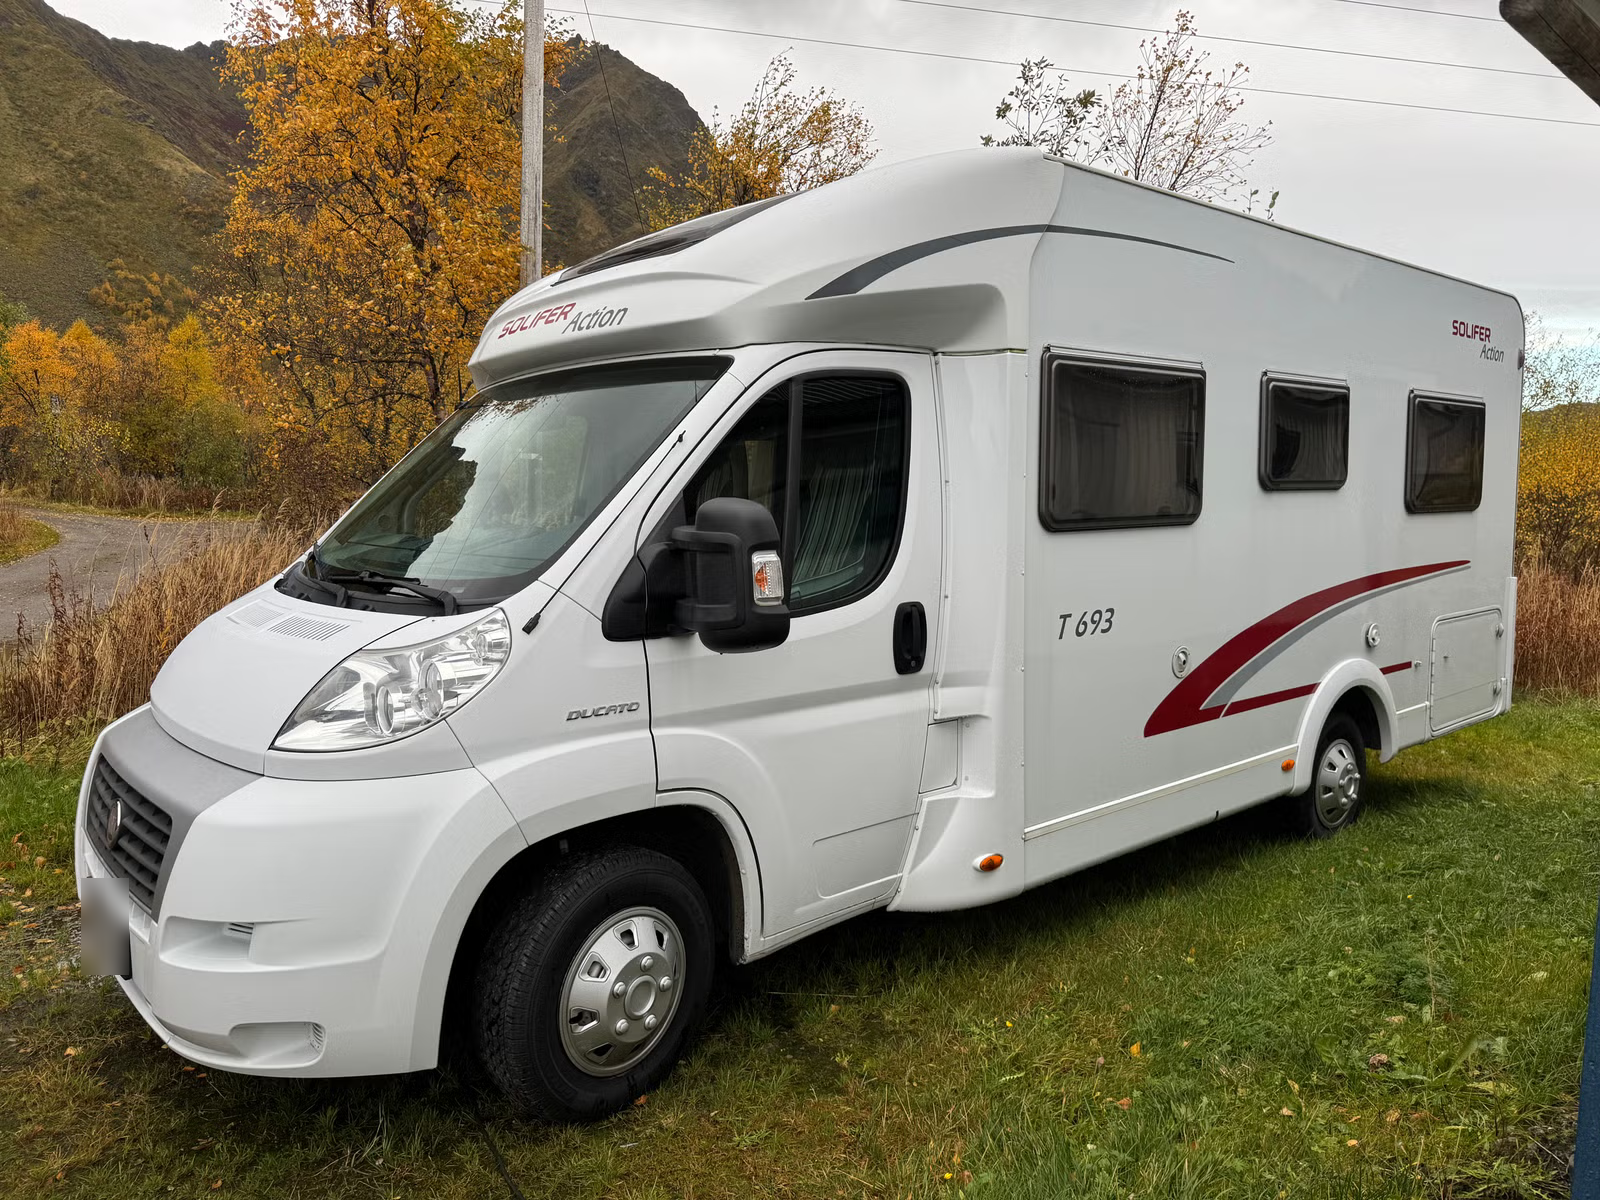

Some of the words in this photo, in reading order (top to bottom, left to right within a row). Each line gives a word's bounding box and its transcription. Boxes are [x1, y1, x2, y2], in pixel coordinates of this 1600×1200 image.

[498, 302, 576, 339] SOLIFER
[561, 306, 628, 334] Action
[1452, 320, 1491, 343] SOLIFER
[1480, 344, 1504, 362] Action
[1058, 613, 1072, 640] T
[1075, 607, 1115, 637] 693
[566, 702, 640, 721] DUCATO
